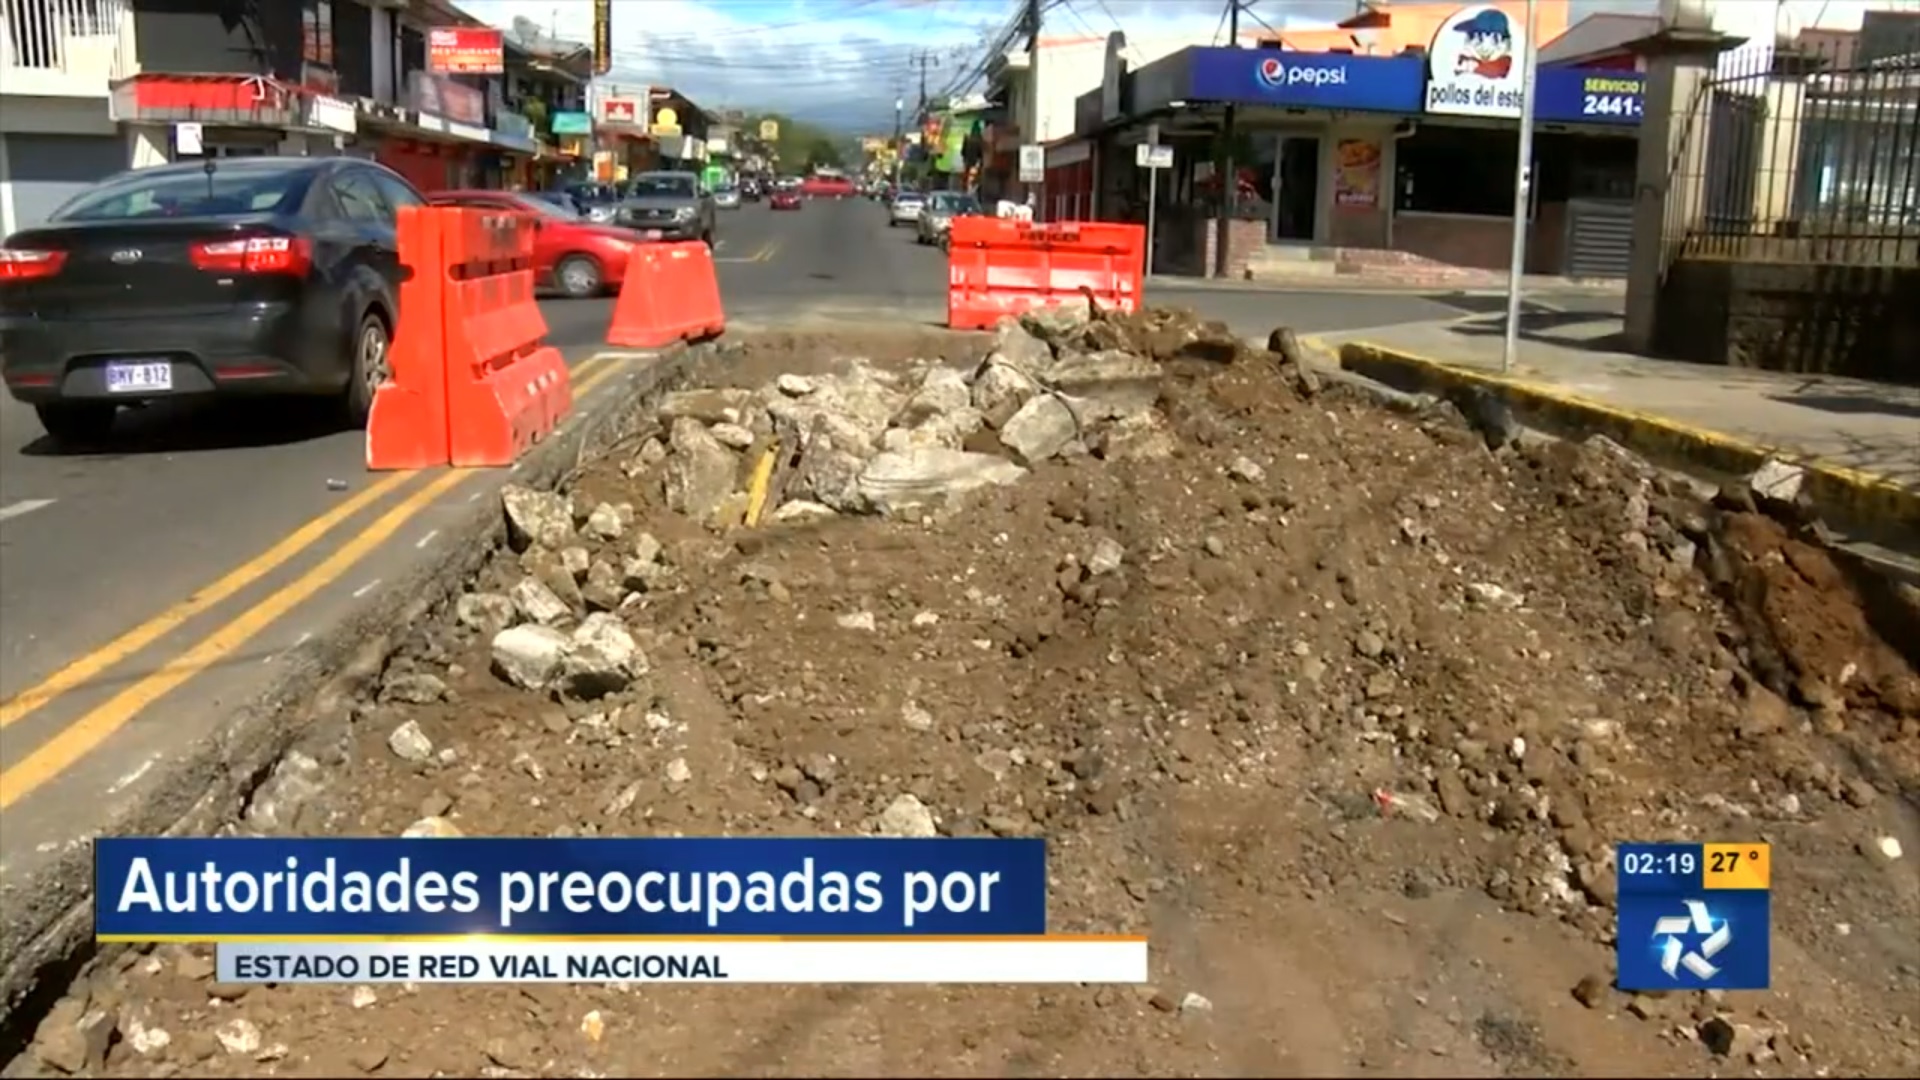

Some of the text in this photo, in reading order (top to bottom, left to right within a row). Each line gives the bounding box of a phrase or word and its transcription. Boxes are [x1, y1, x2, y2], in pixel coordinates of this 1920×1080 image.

[1287, 65, 1346, 87] pepsi
[1584, 78, 1640, 94] SERVICIO
[1430, 83, 1470, 109] pollos
[1474, 84, 1495, 106] del
